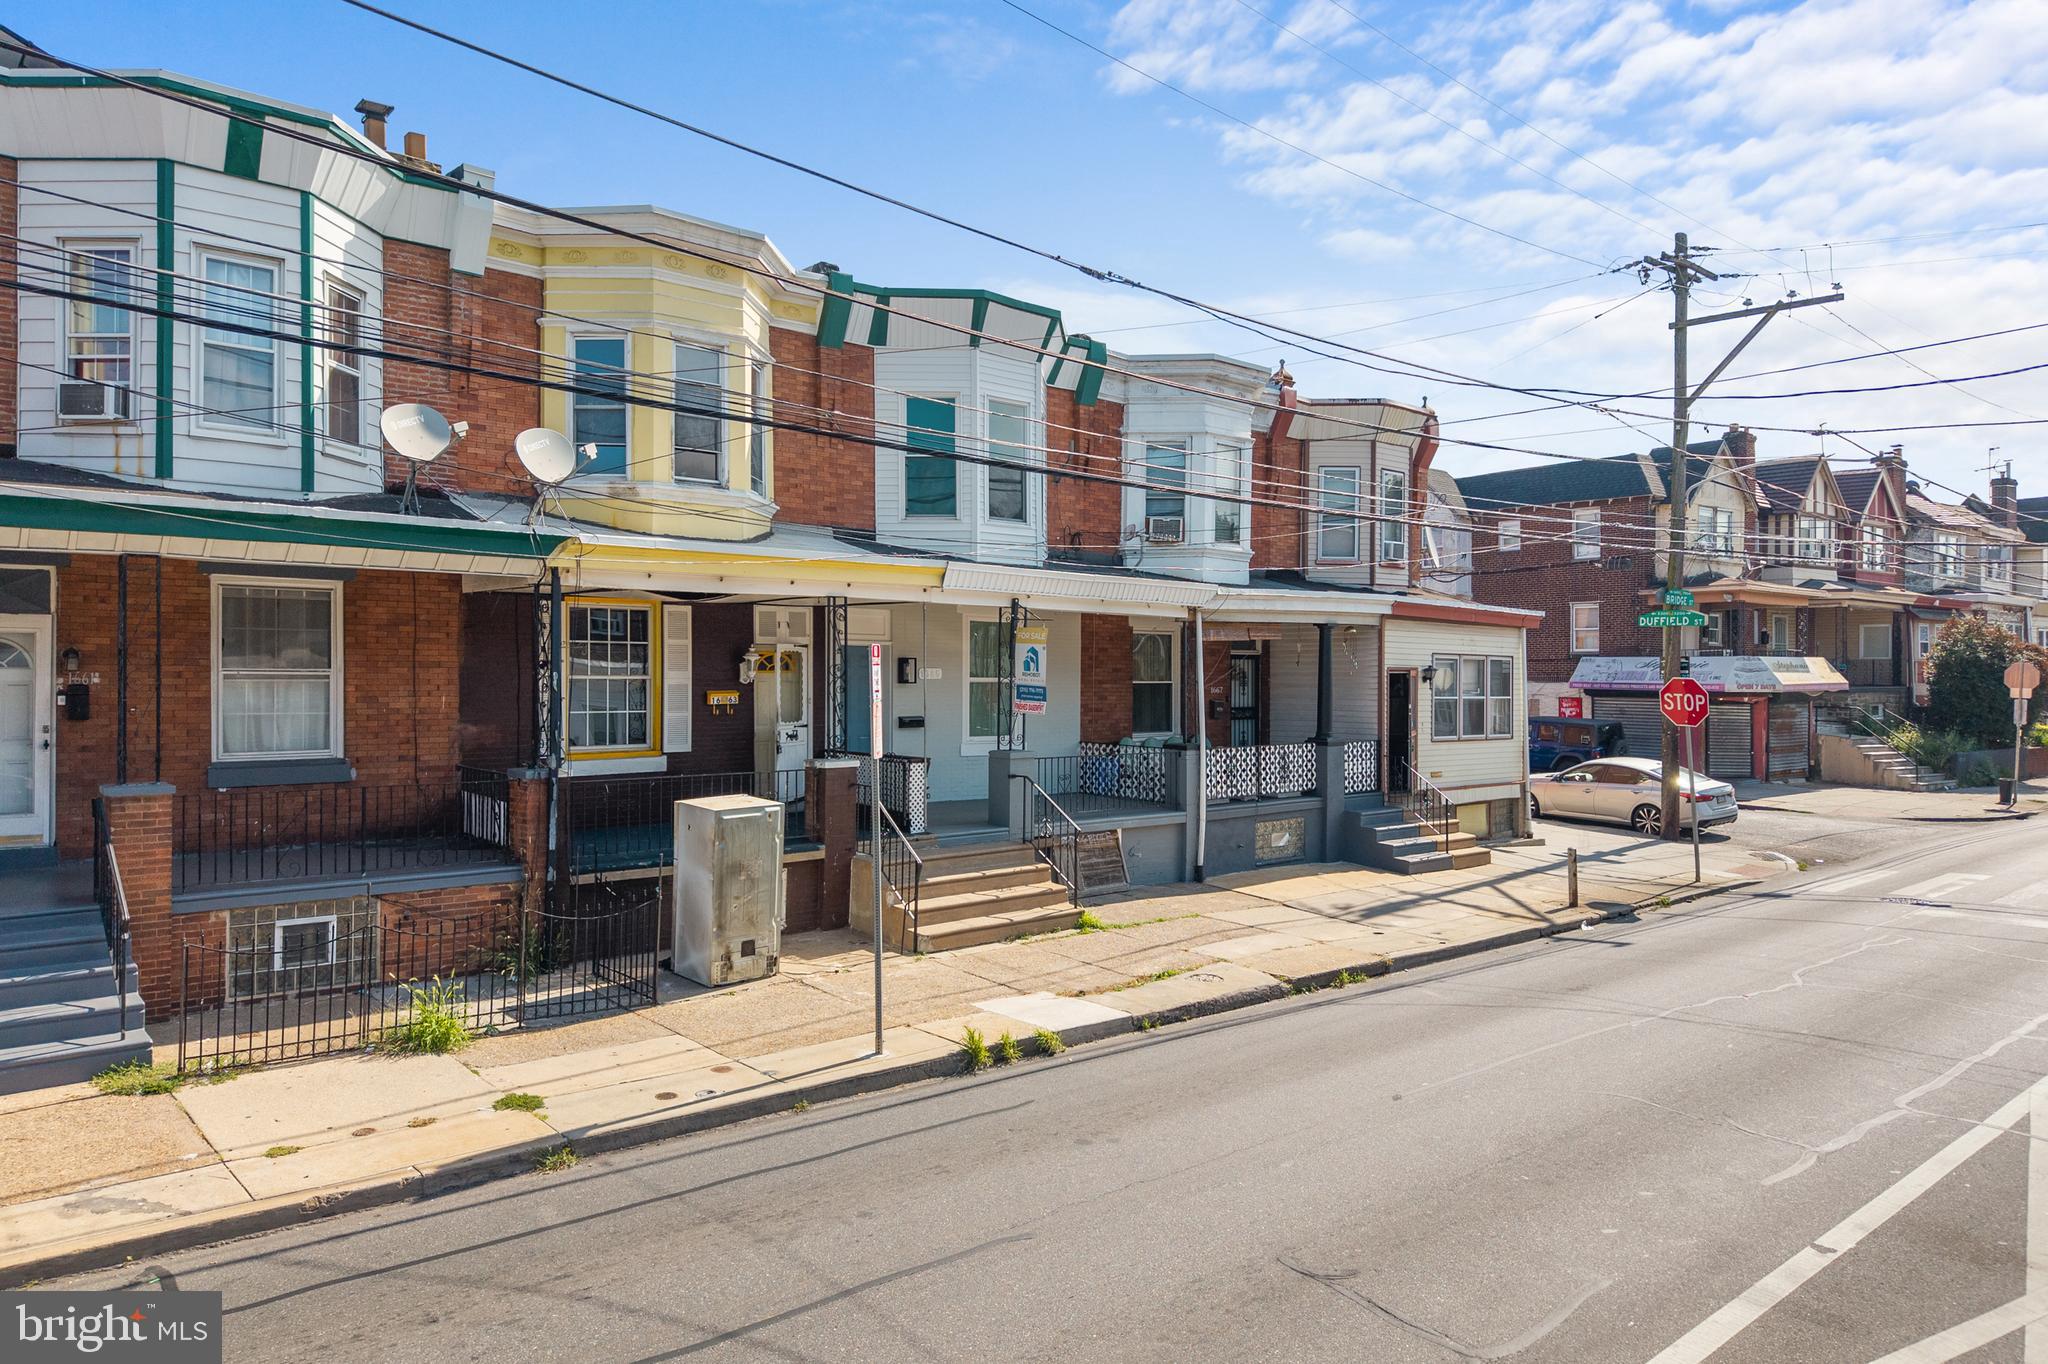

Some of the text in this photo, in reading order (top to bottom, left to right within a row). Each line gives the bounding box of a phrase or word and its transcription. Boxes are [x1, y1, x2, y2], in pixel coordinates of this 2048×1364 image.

[396, 414, 425, 428] DIRECTV
[1666, 594, 1688, 606] BRIDGE
[1639, 616, 1703, 626] DUFFIELD ST
[1030, 632, 1047, 641] SALE
[1663, 692, 1705, 712] STOP
